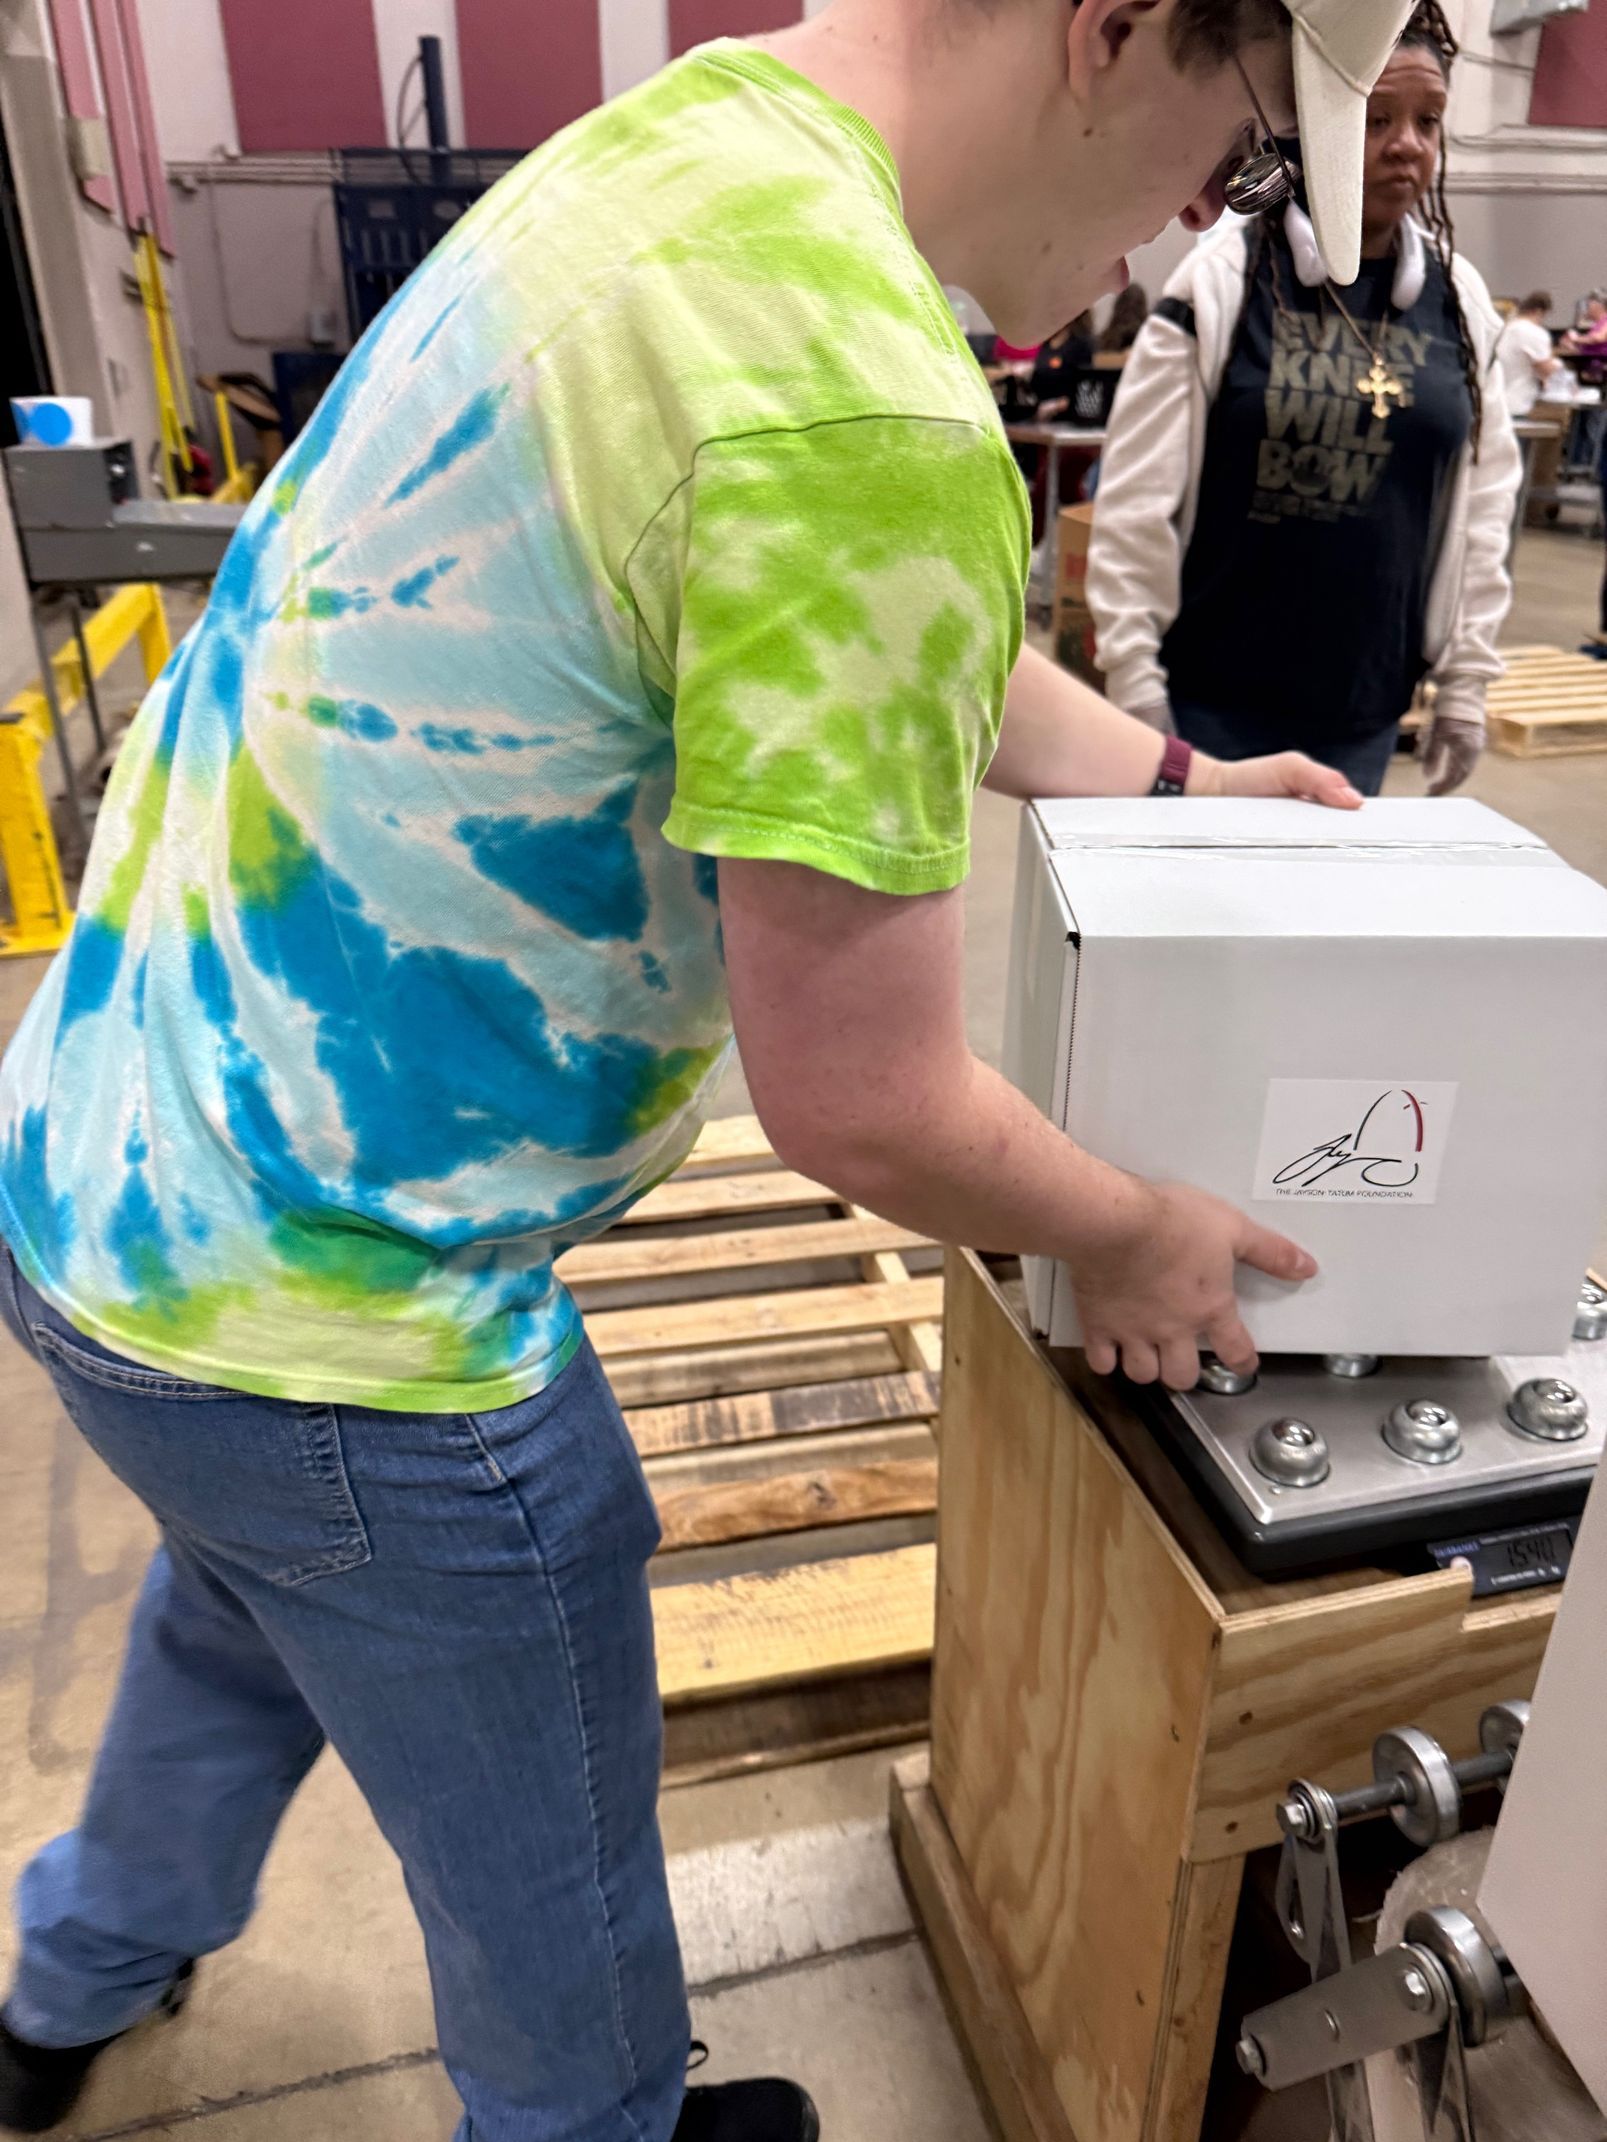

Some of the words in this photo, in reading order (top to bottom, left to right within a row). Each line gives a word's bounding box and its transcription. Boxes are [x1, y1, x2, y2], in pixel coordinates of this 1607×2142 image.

[1272, 310, 1431, 367] EVERY
[1265, 389, 1395, 455] WILL
[1257, 440, 1389, 501] BOW
[1327, 1190, 1355, 1198] TATUM
[1357, 1190, 1413, 1198] FOUNDATION
